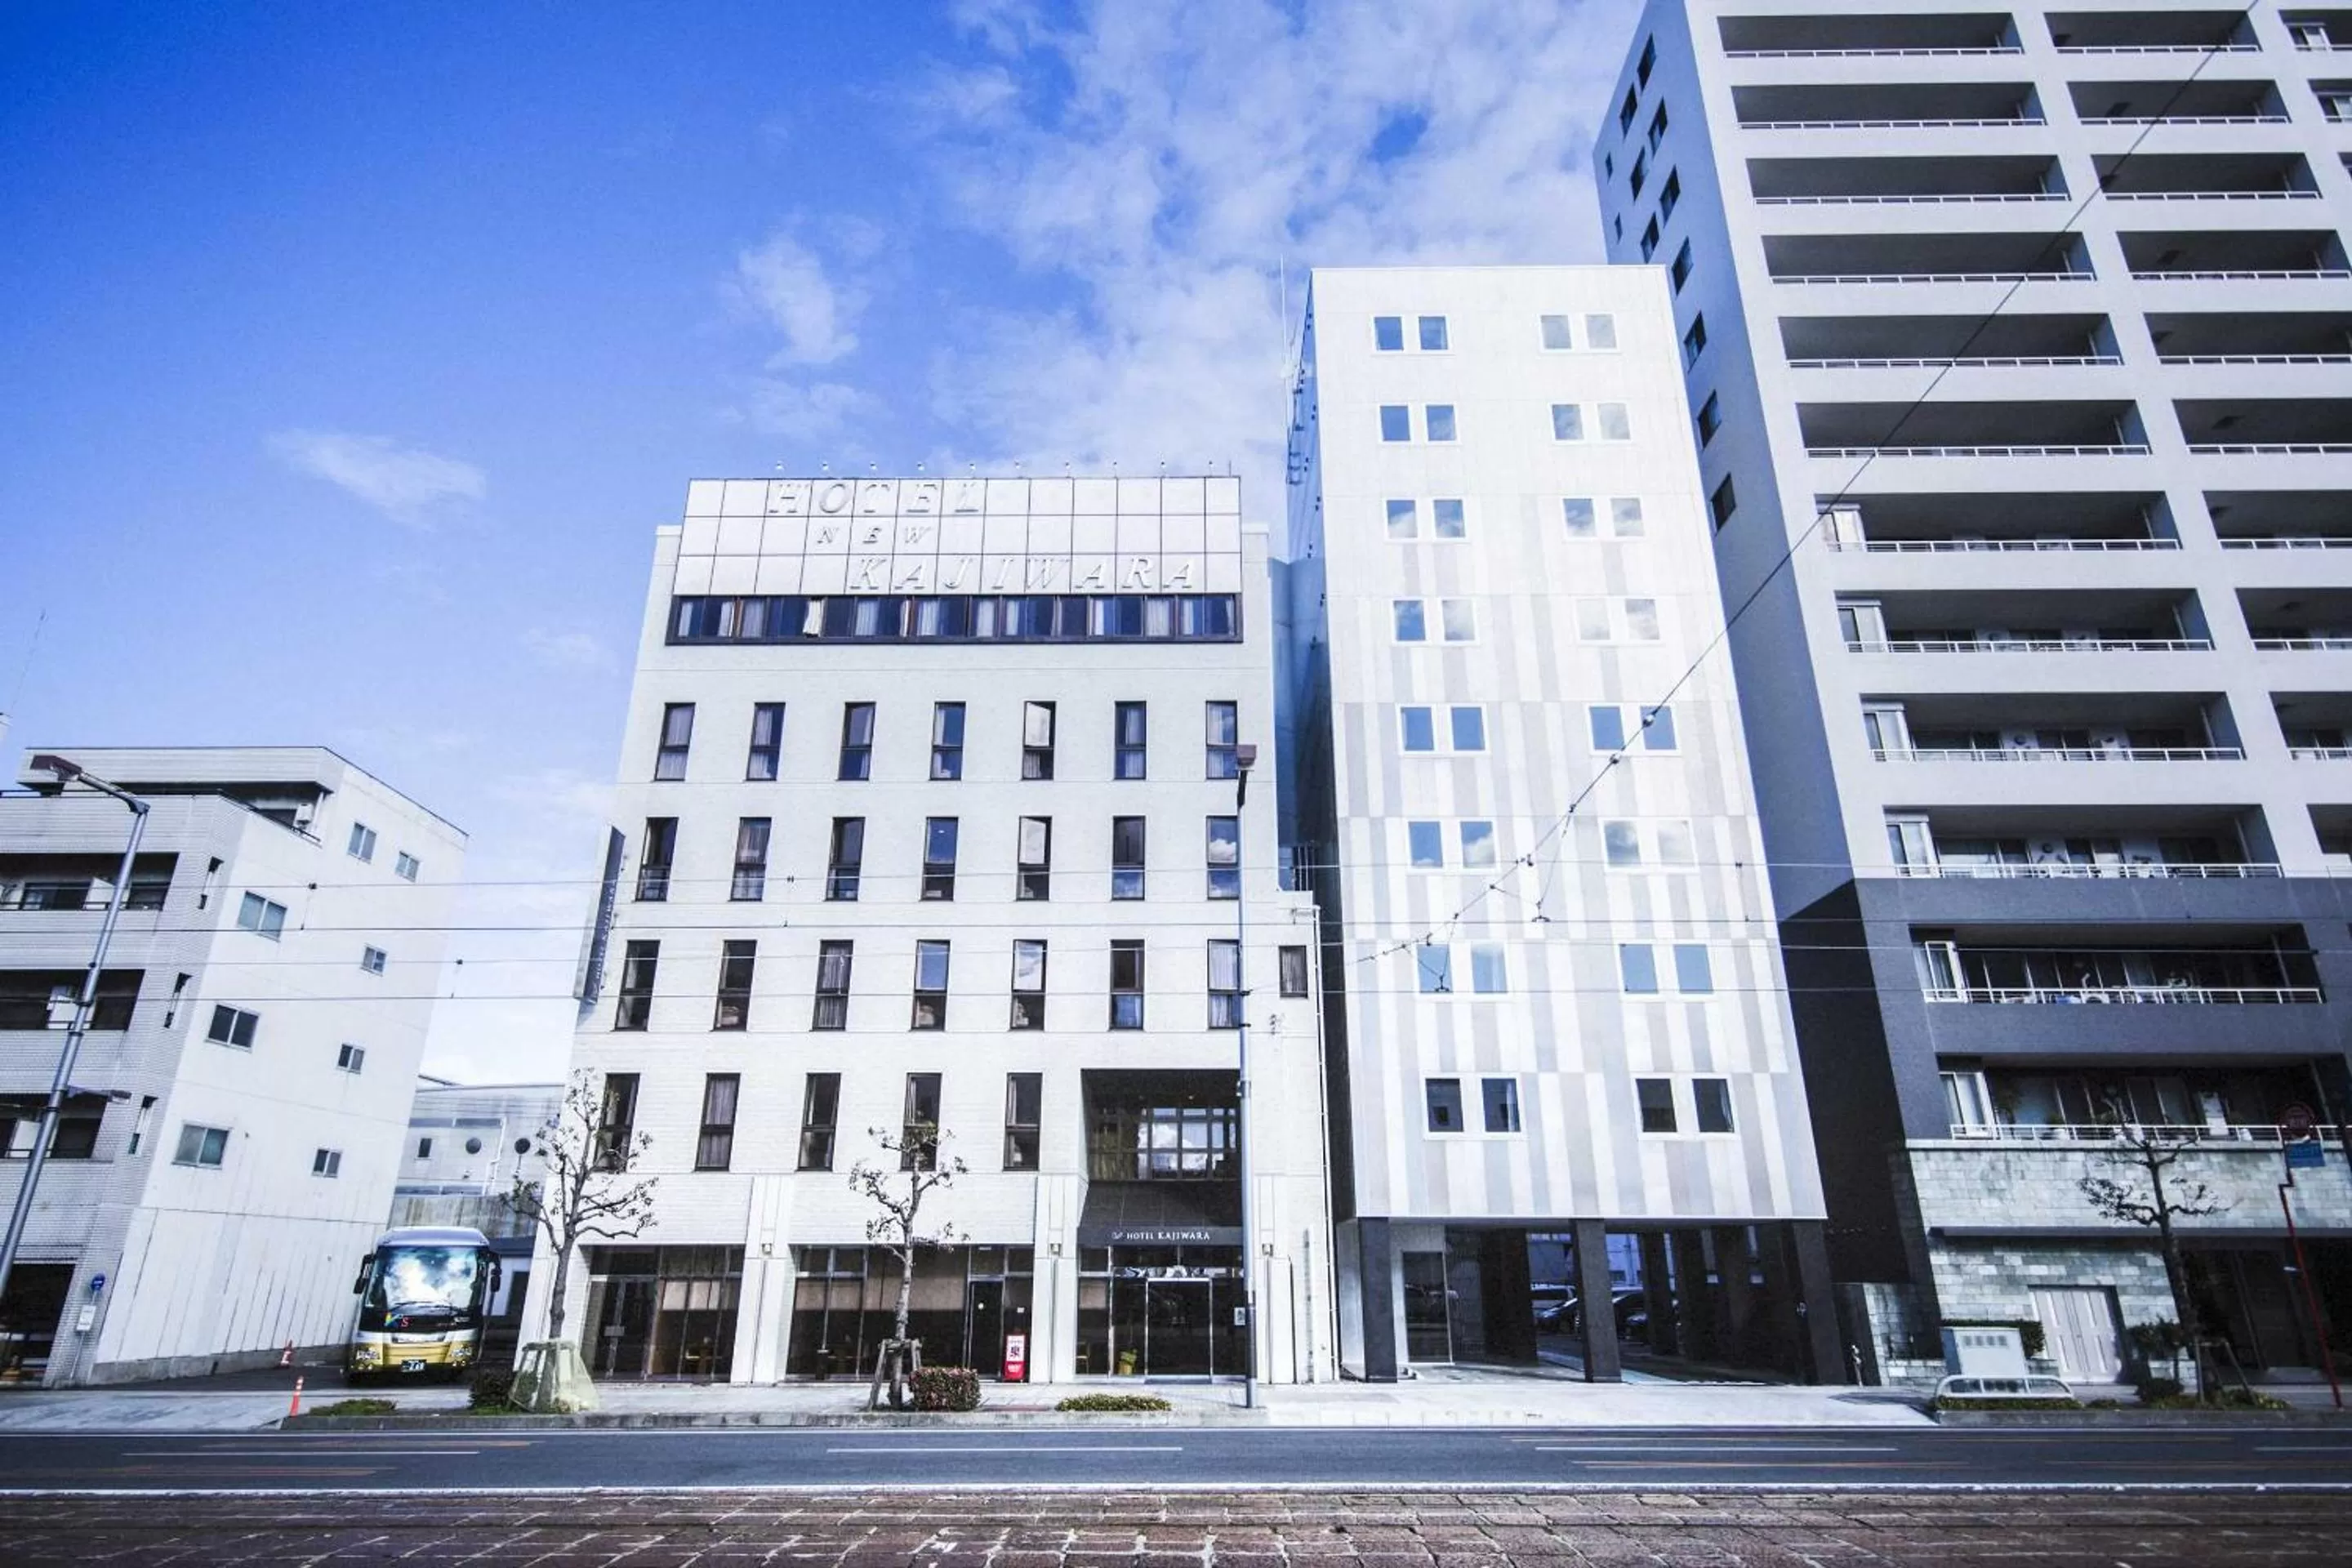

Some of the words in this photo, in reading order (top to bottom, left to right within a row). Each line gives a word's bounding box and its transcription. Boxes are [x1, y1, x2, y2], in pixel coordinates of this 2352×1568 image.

[768, 483, 979, 514] HOTEL
[817, 526, 933, 545] NEW
[849, 557, 1194, 590] KAJIWARA
[1126, 1231, 1154, 1241] HOTEL
[1157, 1231, 1210, 1241] KAJIWARA
